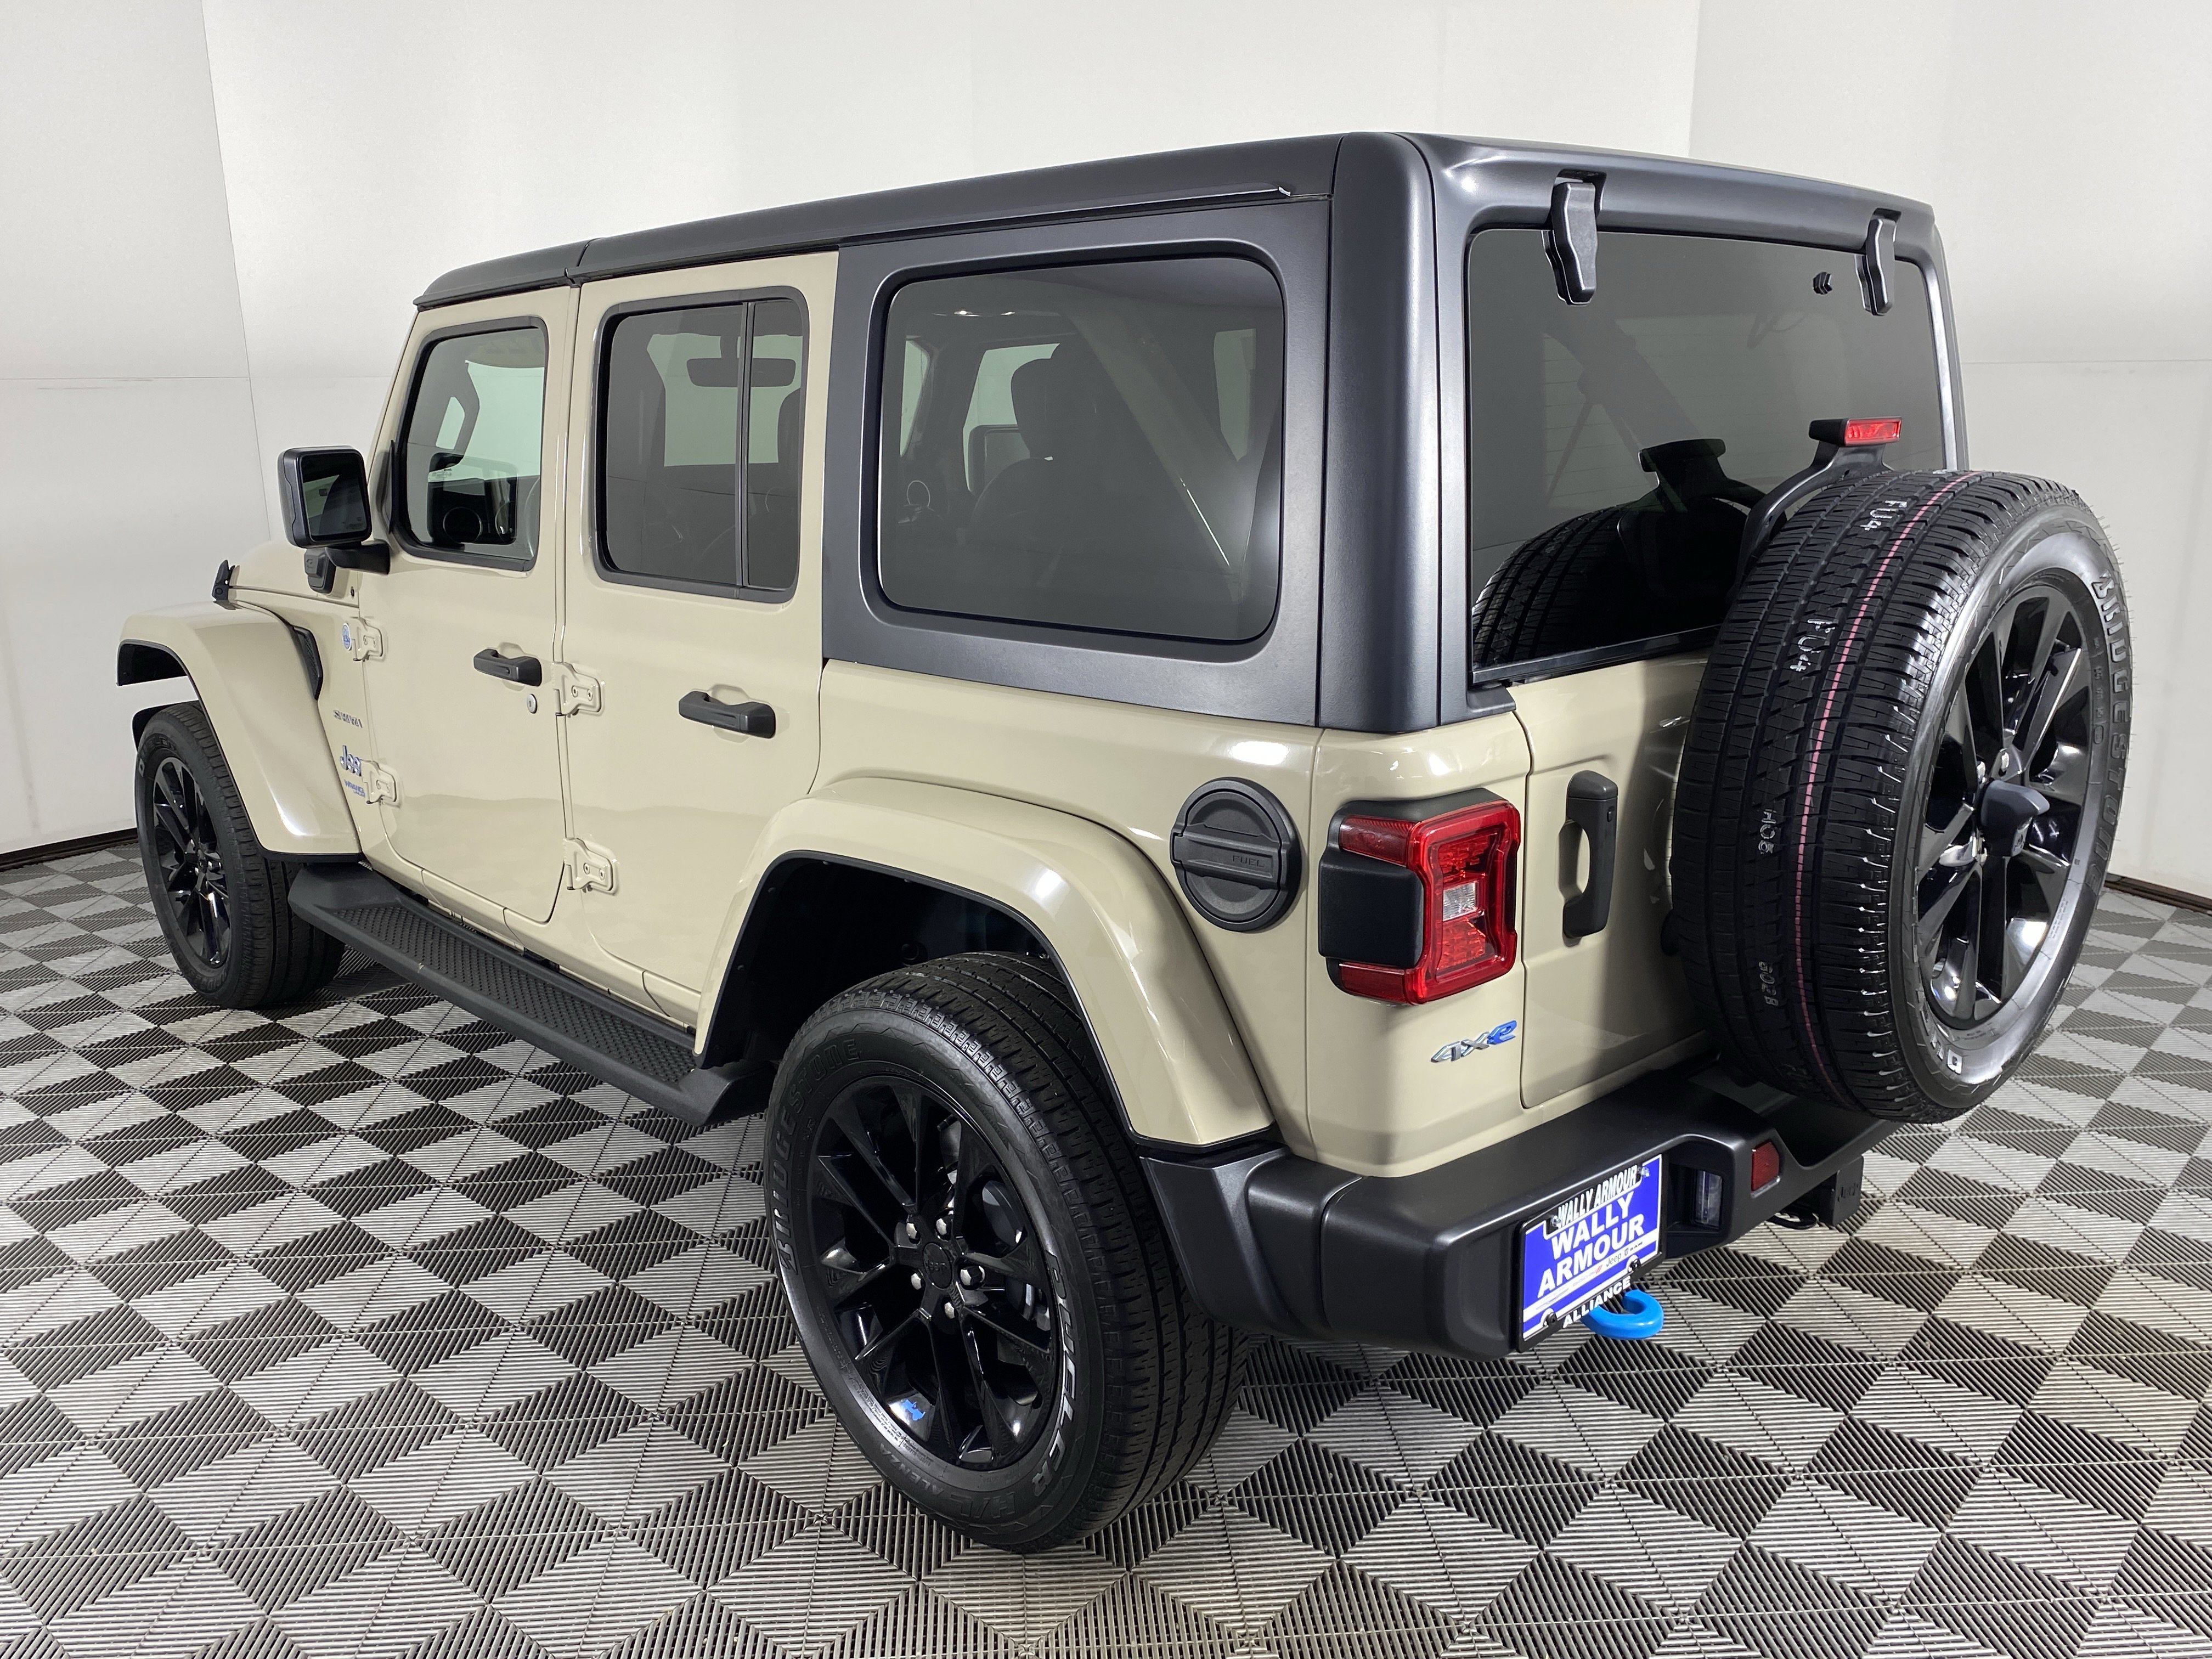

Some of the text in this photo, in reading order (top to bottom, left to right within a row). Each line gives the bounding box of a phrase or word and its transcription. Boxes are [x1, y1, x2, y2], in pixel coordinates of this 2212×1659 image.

[2086, 569, 2130, 896] BRIDGESTONE
[1232, 855, 1265, 868] FUEL
[772, 1039, 860, 1276] BRIDGESTONE
[1551, 1190, 1634, 1260] WALLY
[1558, 1164, 1638, 1228] WALLY ARMOUR
[1537, 1213, 1645, 1299] ARMOUR
[1606, 1252, 1622, 1267] Jeep
[1562, 1275, 1632, 1329] ALLIANCE
[1032, 1250, 1076, 1497] DUELER
[879, 1442, 945, 1494] ALENZA
